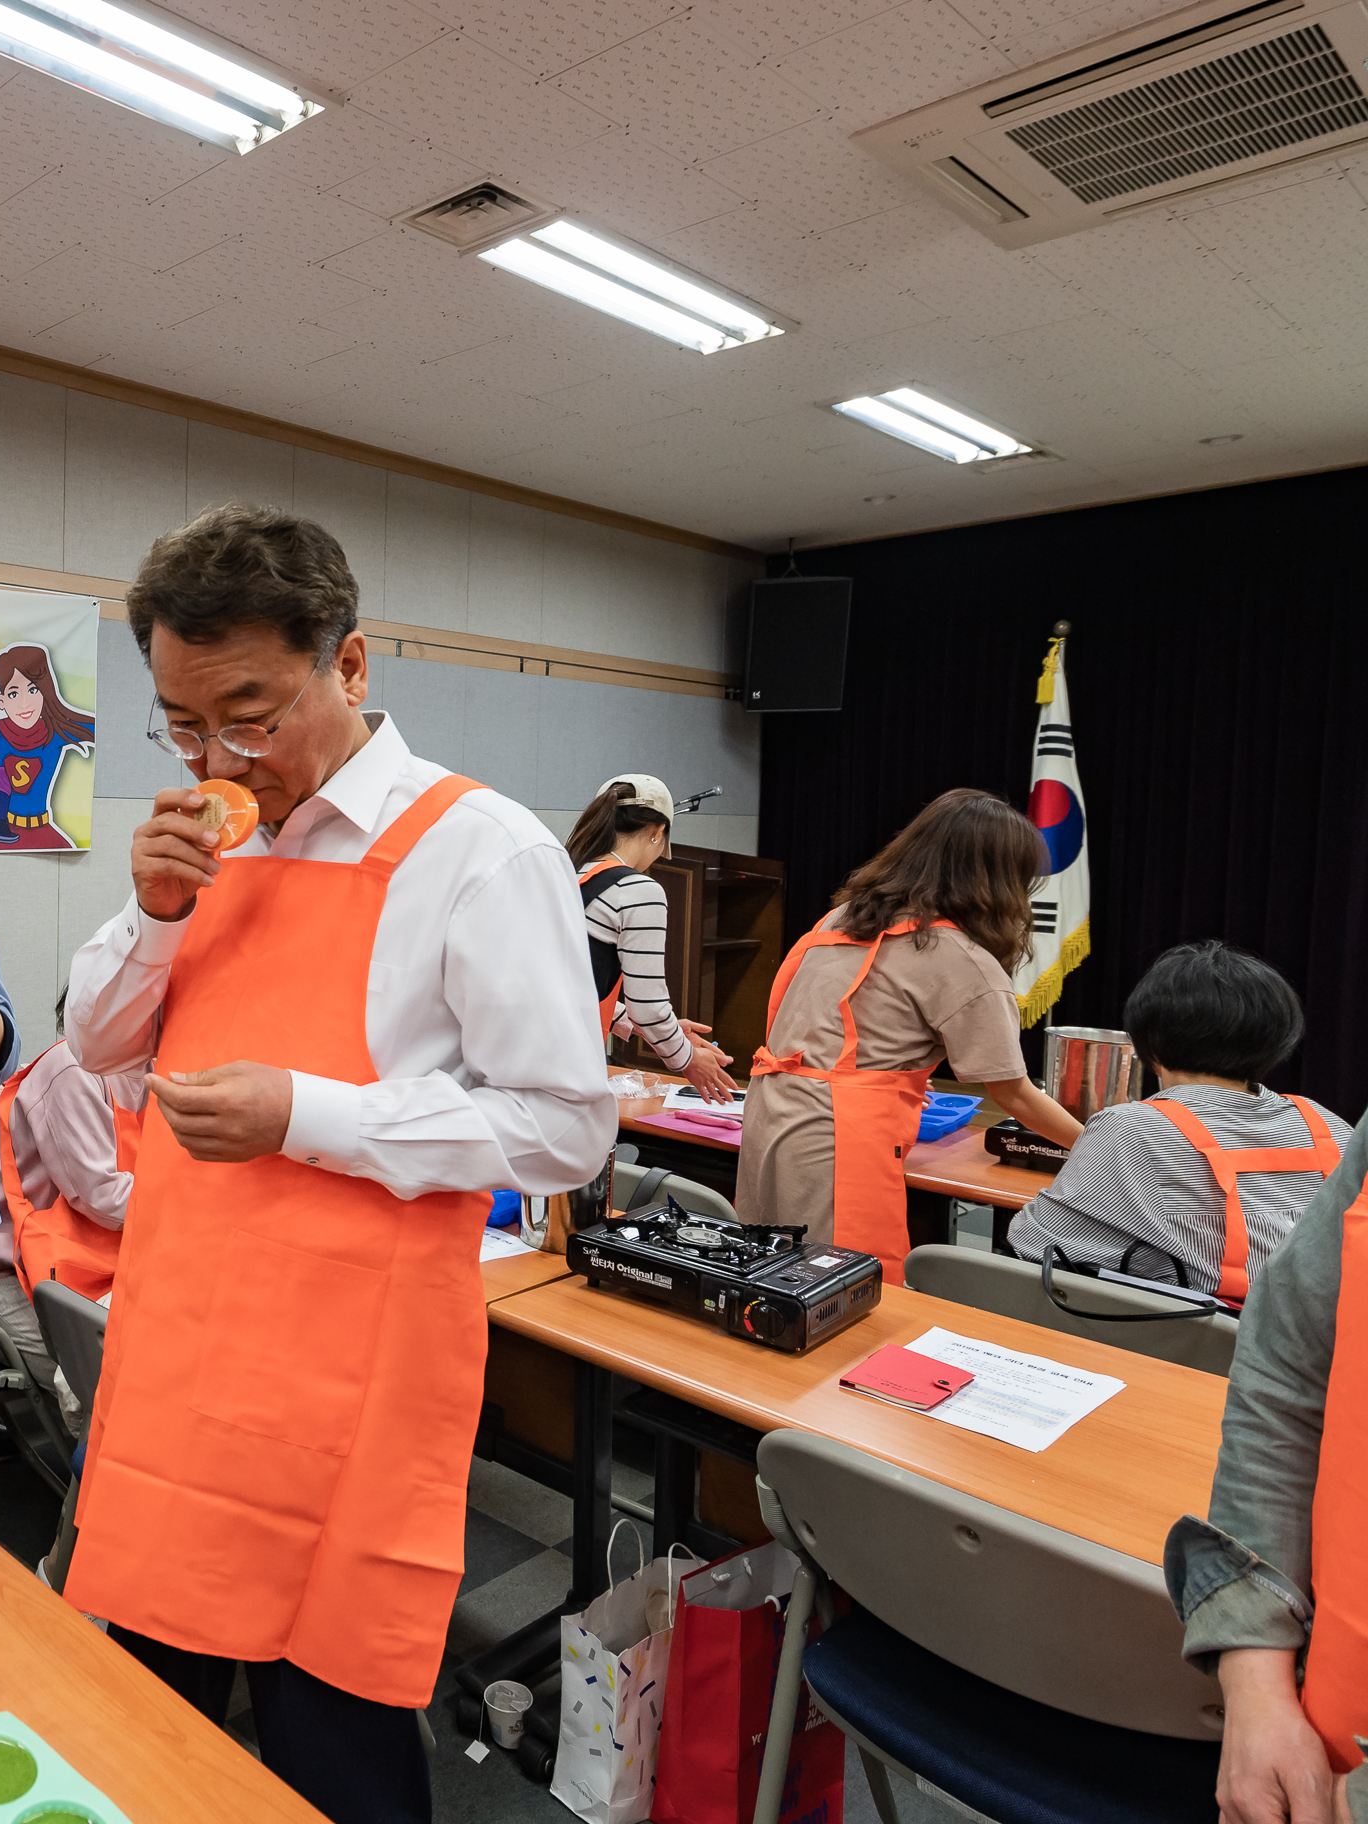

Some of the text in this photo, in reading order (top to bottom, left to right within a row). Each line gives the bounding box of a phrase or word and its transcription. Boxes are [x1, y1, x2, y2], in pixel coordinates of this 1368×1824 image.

[1029, 1144, 1062, 1156] Original
[590, 1256, 615, 1271] 썬터치
[616, 1263, 653, 1281] Original
